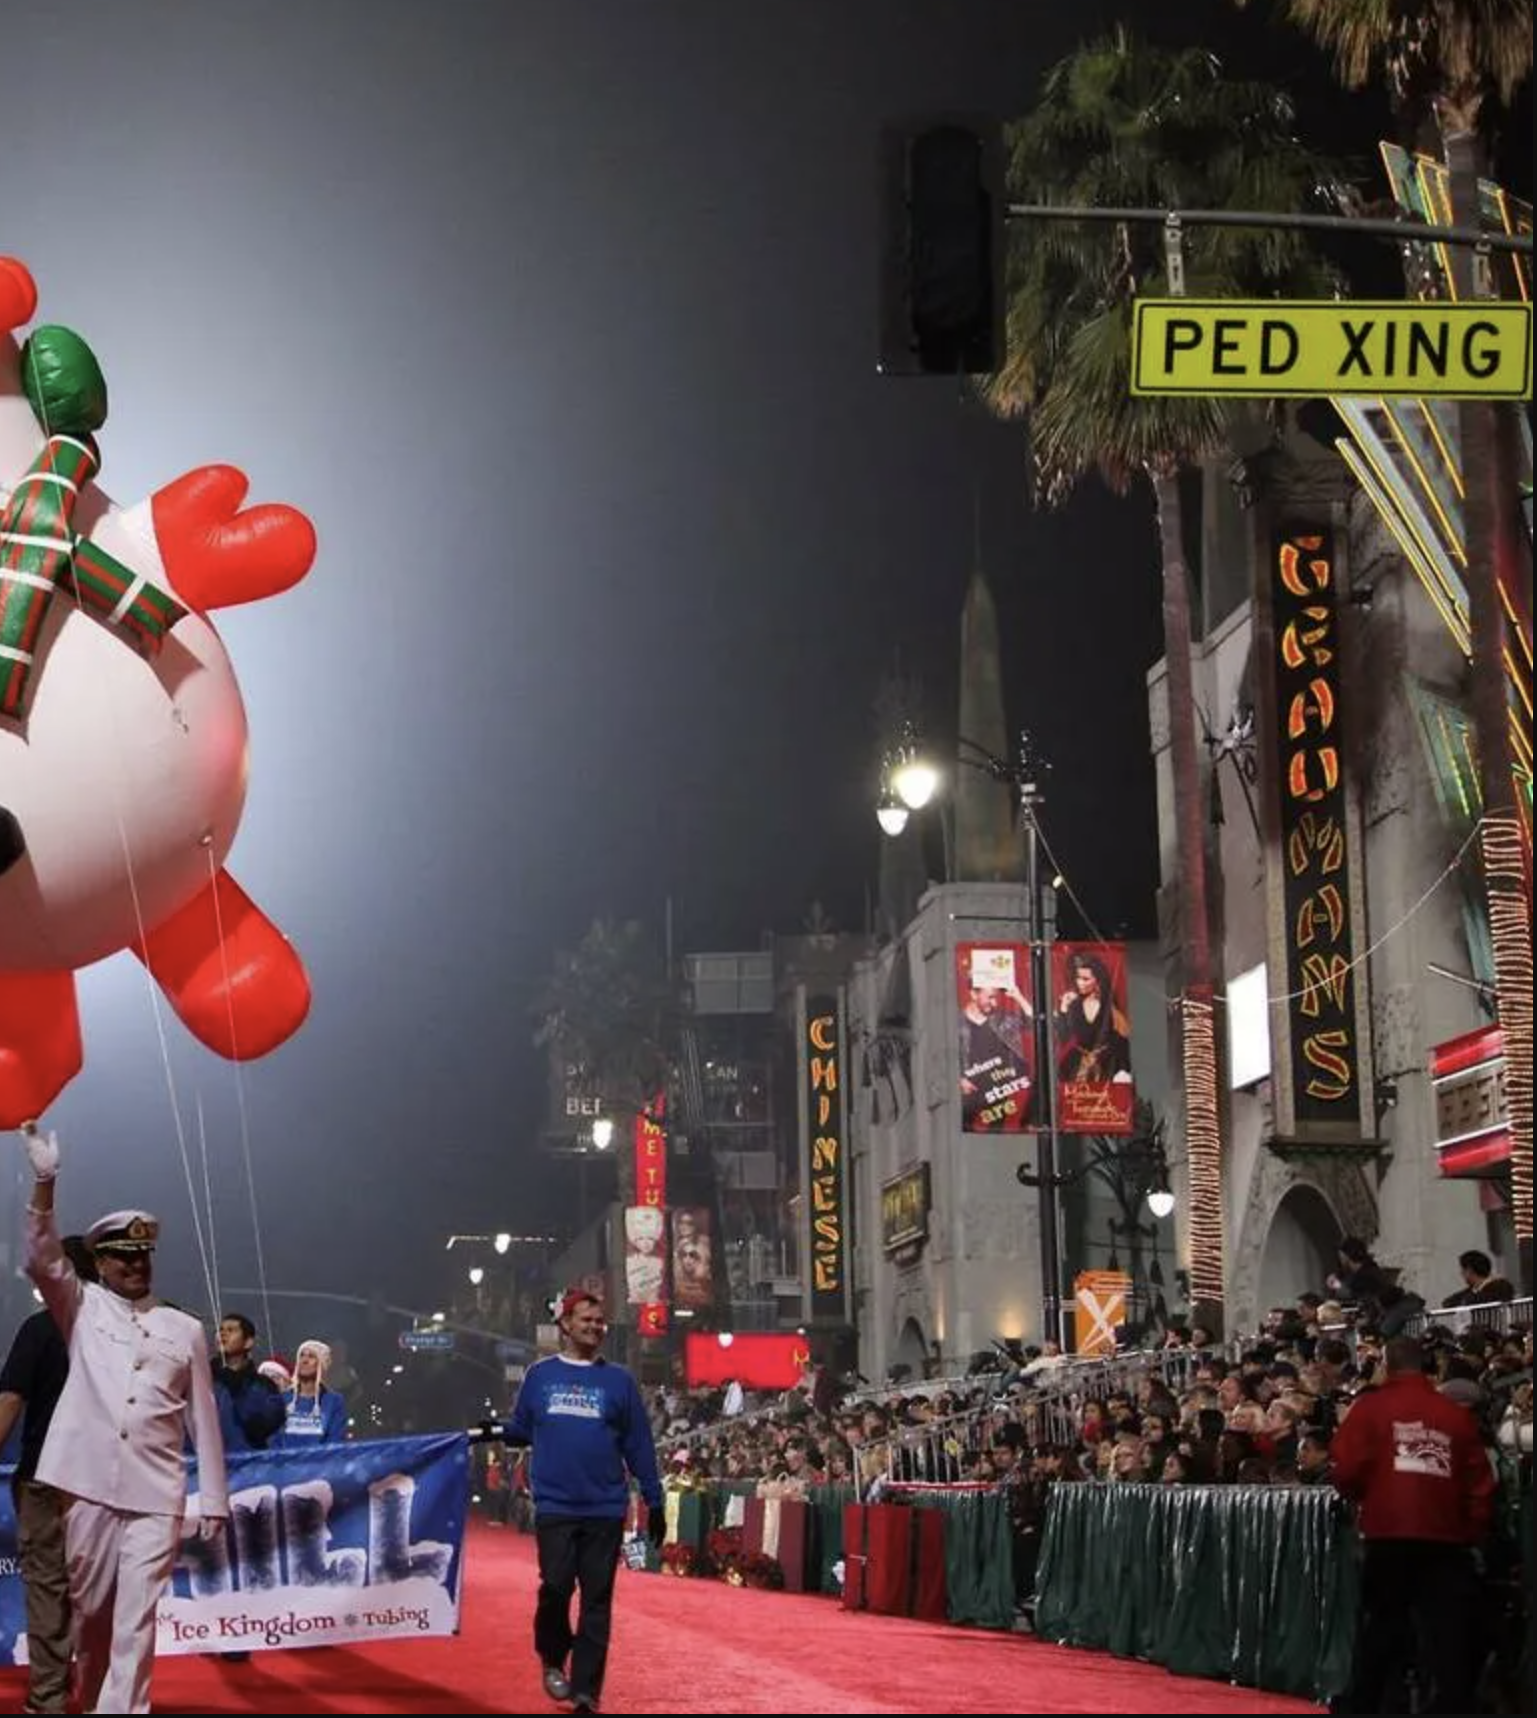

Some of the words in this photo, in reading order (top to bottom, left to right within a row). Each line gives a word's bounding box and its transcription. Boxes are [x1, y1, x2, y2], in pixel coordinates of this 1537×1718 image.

[1163, 319, 1300, 375] PED
[1337, 320, 1501, 379] XING
[984, 1076, 1031, 1104] stars
[979, 1100, 1018, 1123] are
[810, 1016, 839, 1290] CHINESE
[172, 1620, 210, 1641] Ice
[218, 1612, 336, 1646] Kingdom
[363, 1608, 430, 1630] Tubing
